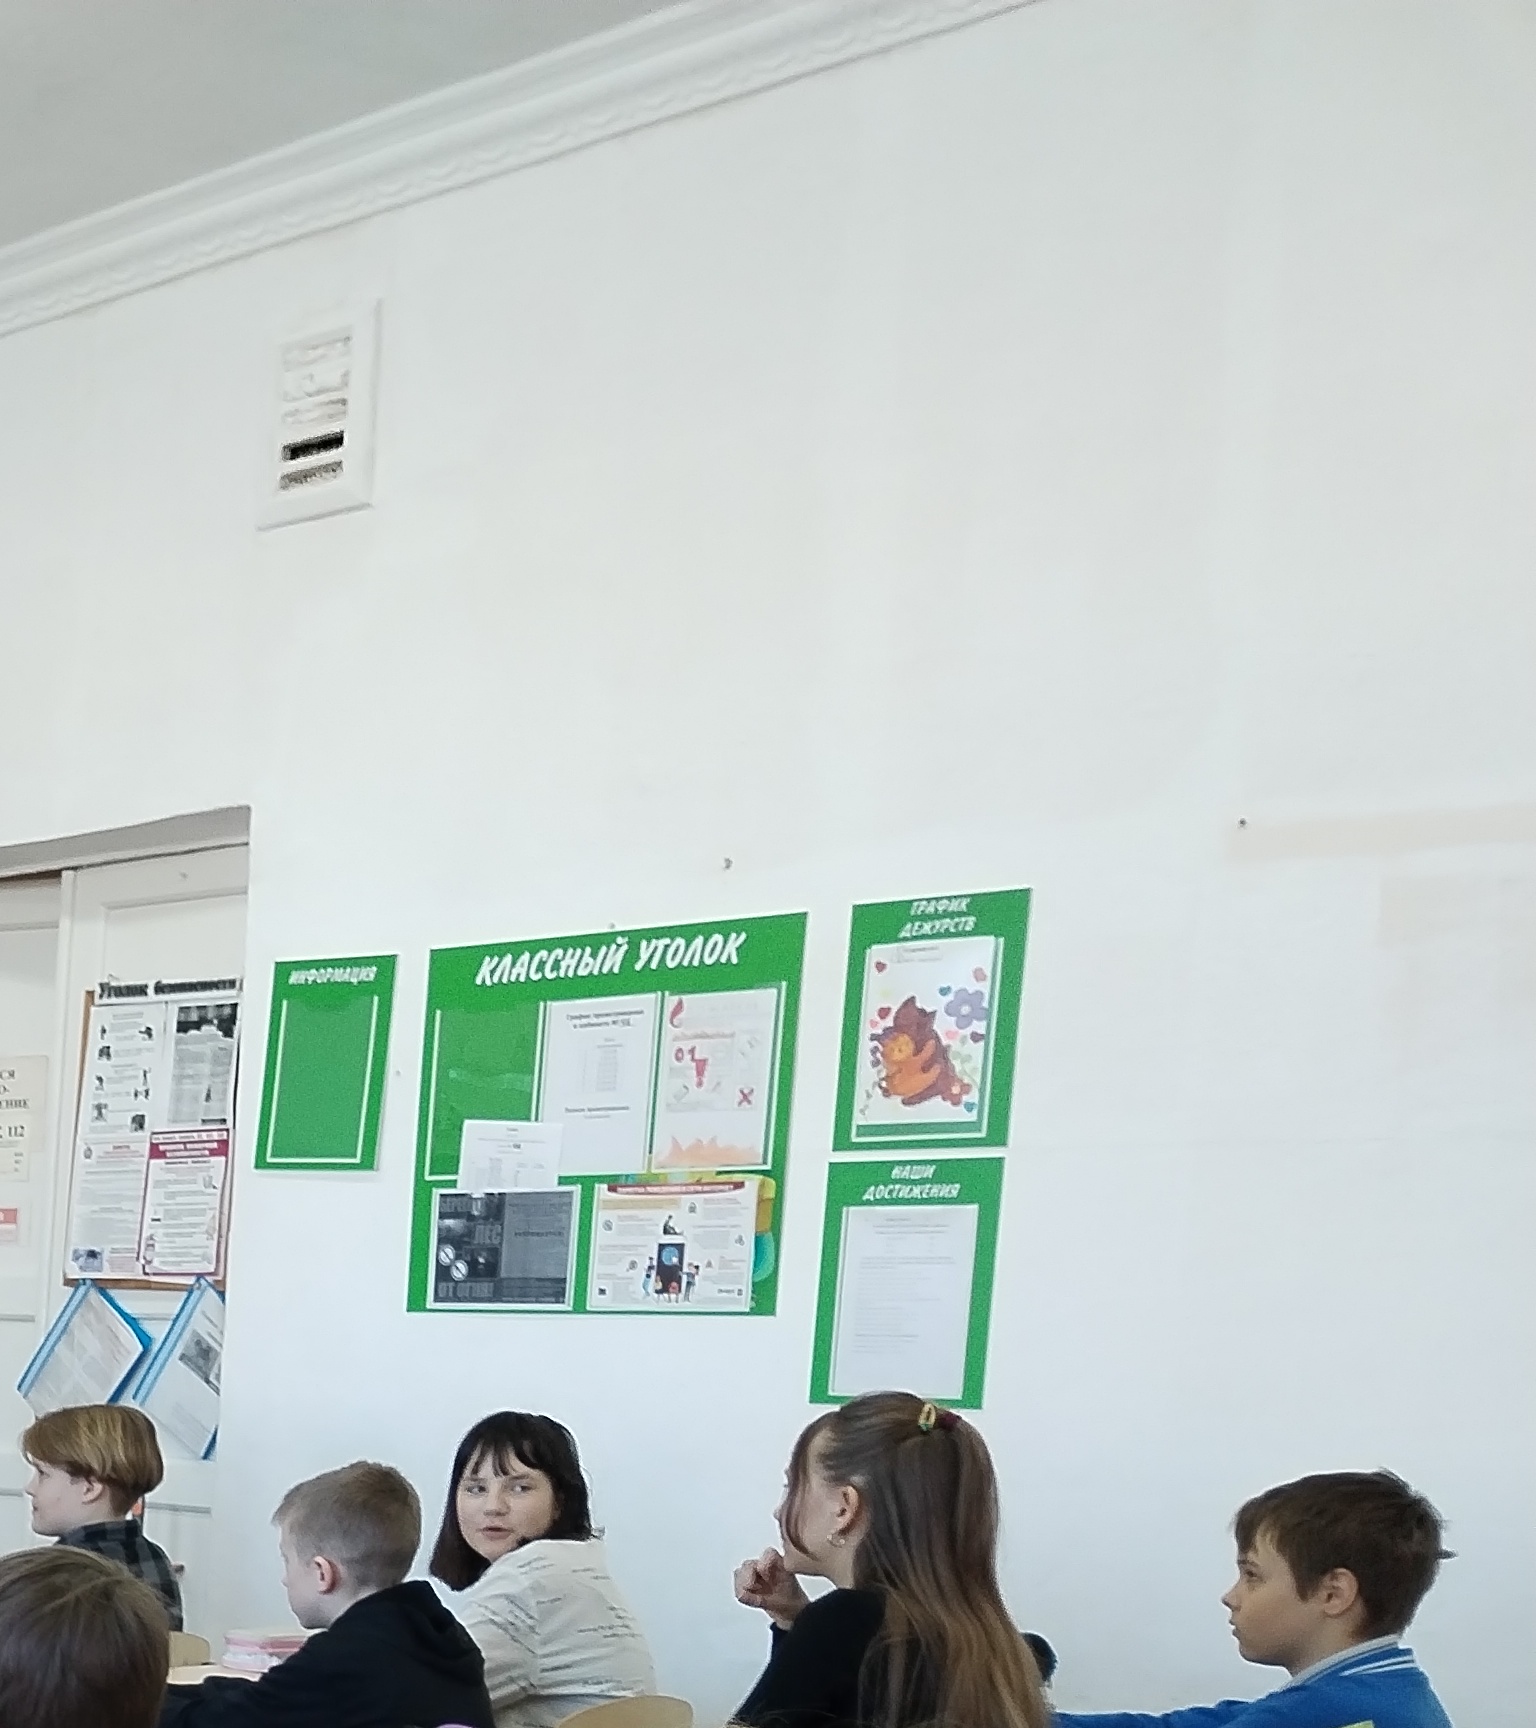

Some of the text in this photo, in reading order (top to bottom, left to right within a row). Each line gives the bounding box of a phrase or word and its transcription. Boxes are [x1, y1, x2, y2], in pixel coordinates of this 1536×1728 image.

[910, 897, 971, 916] ГРАФИК
[475, 931, 747, 986] КЛАССНЫЙ УГОЛОК
[289, 965, 378, 985] ИНФОРМАЦИЯ
[891, 1164, 937, 1180] НАШИ
[862, 1182, 962, 1202] ДОСТИЖЕНИЯ
